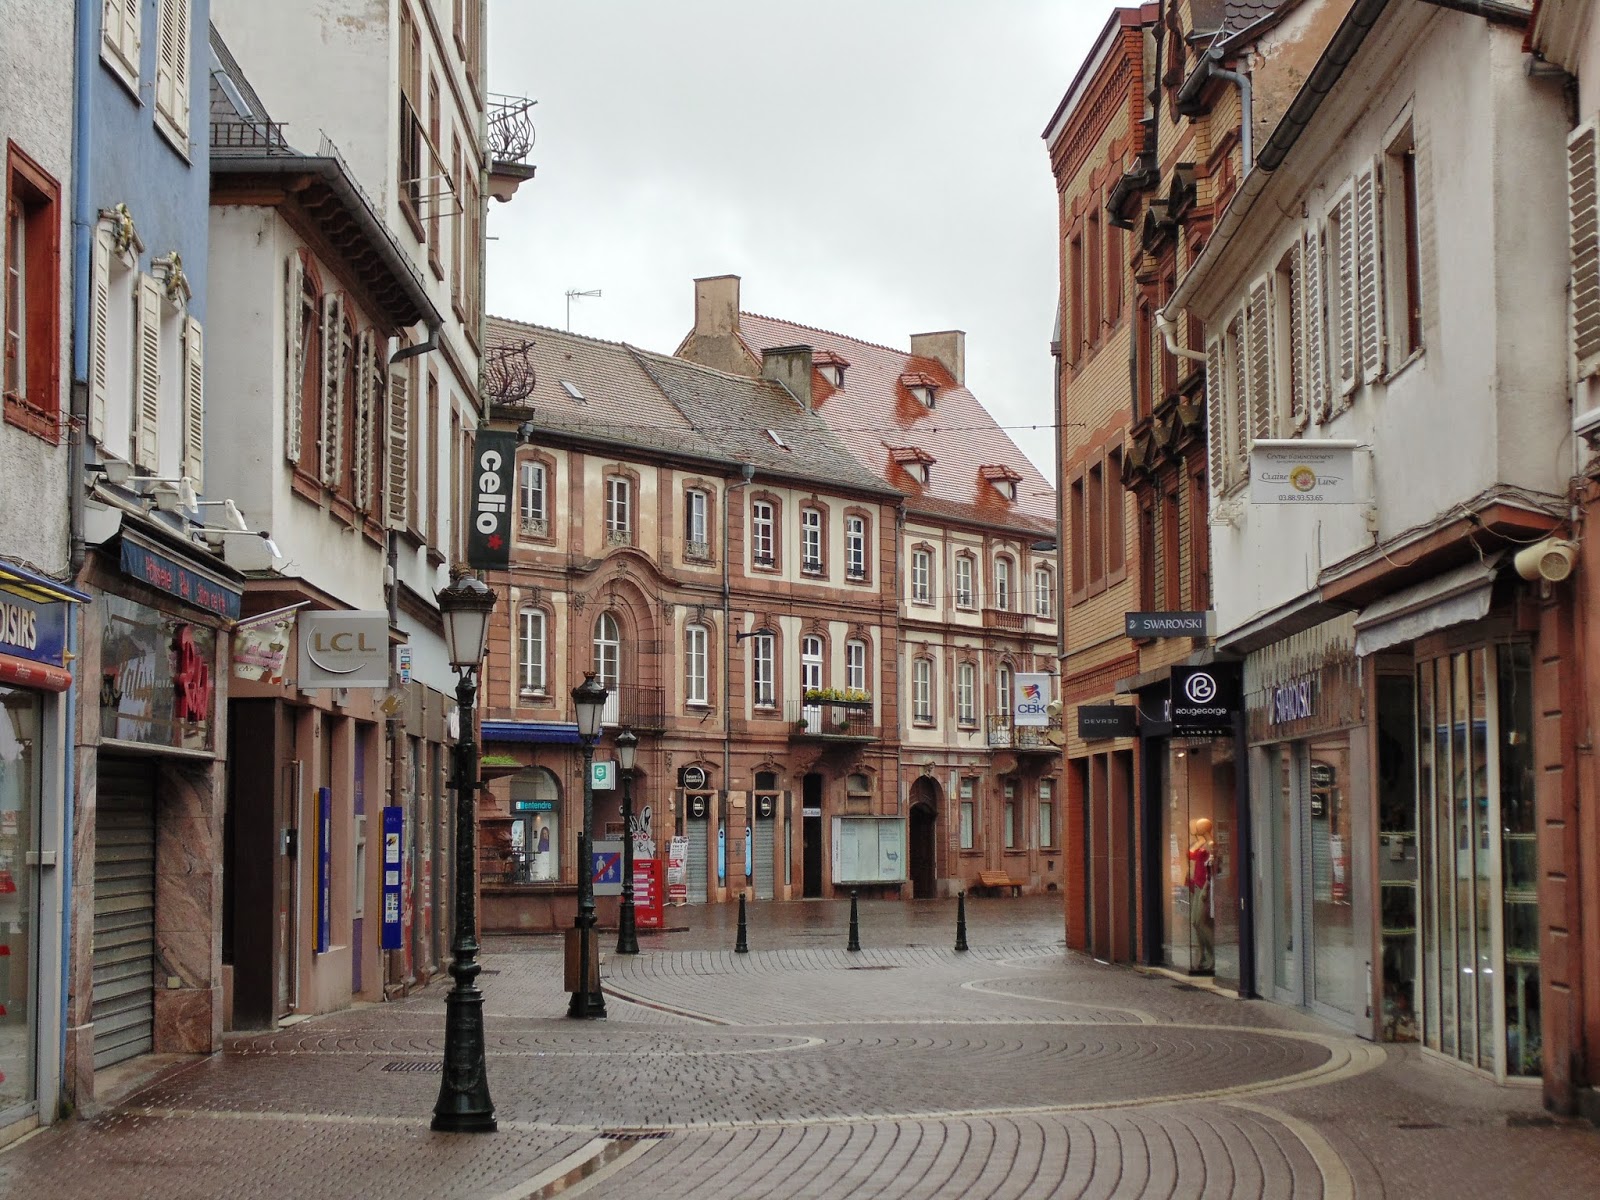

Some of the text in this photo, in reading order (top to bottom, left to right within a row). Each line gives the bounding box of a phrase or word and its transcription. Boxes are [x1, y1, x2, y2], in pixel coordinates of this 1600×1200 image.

[476, 450, 506, 534] celio
[1143, 619, 1203, 629] SWAROVSKI
[314, 632, 377, 652] LCL
[1018, 704, 1046, 714] CBK
[1276, 680, 1311, 724] SWAROVSKI
[525, 801, 552, 809] entendre
